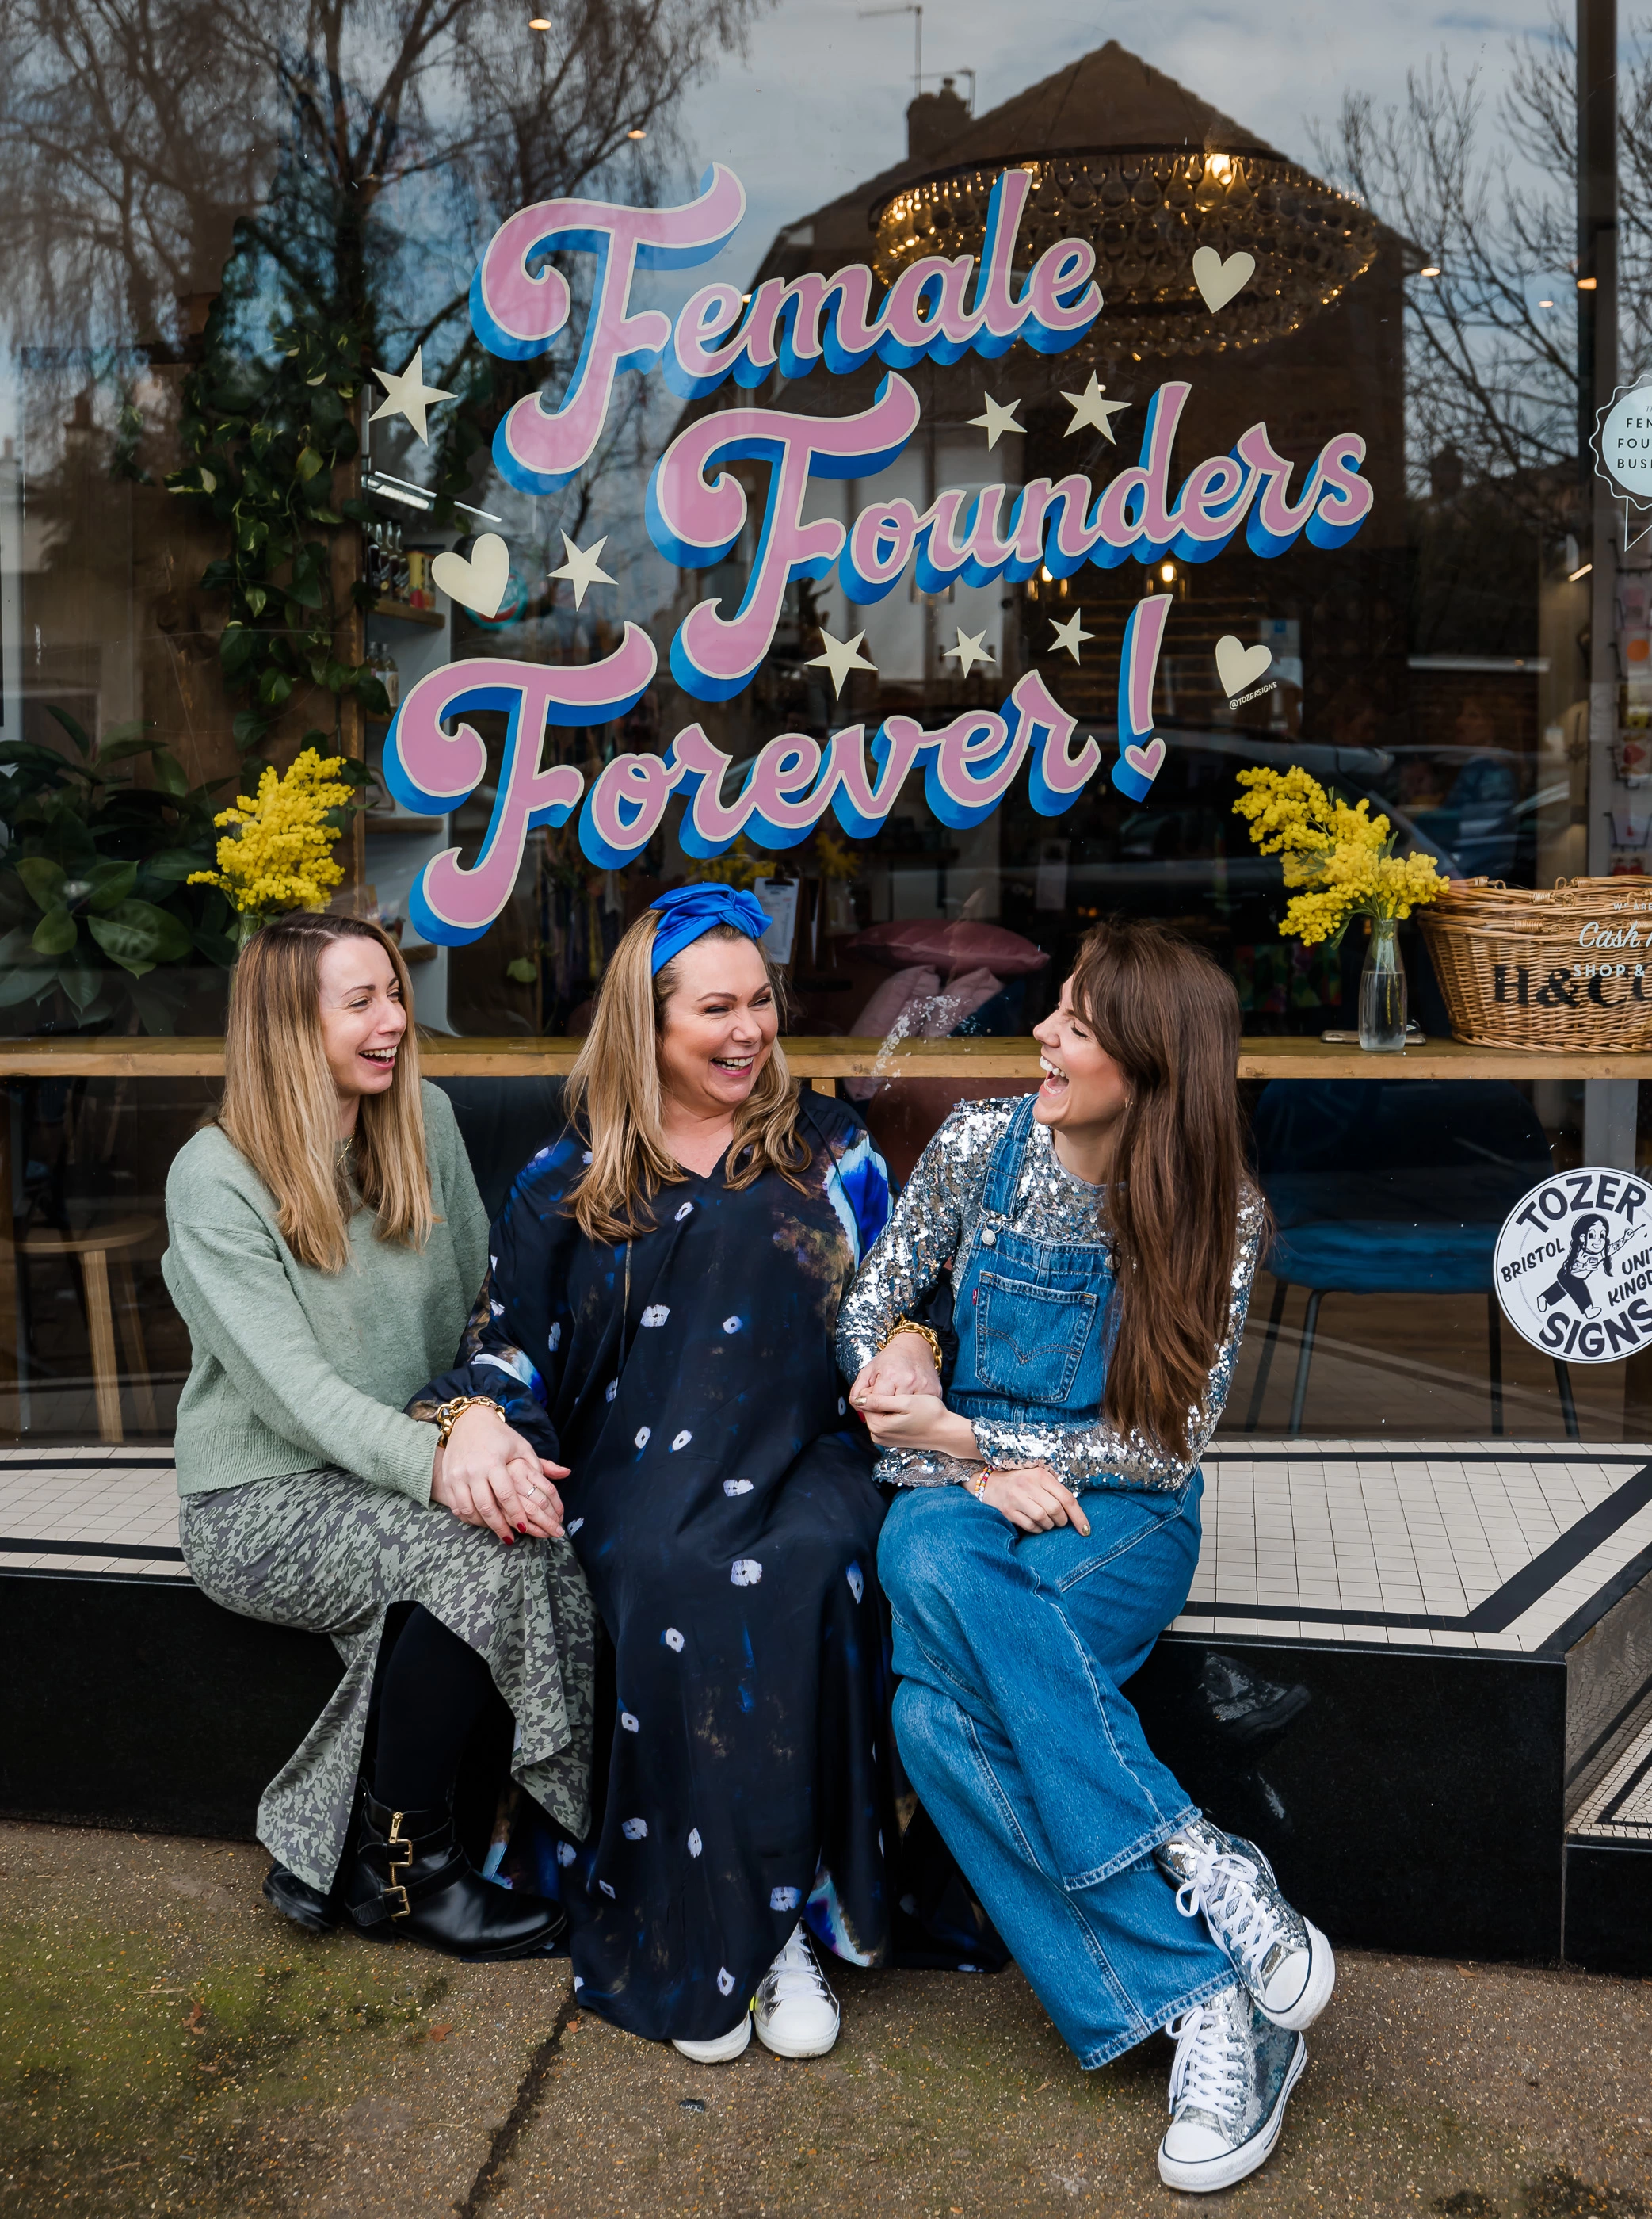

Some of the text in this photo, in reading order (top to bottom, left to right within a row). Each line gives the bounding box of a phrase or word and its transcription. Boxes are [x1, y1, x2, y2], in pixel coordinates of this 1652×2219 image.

[469, 162, 1103, 495] Female
[645, 370, 1373, 702] Founders
[1229, 681, 1278, 710] @TOZERSIGNS
[383, 594, 1173, 946] Forever!
[1579, 920, 1641, 949] Cash
[1573, 964, 1646, 977] SHOP &
[1515, 1174, 1647, 1234] TOZER
[1501, 1238, 1565, 1283] BRISTOL
[1539, 1298, 1652, 1358] SIGNS
